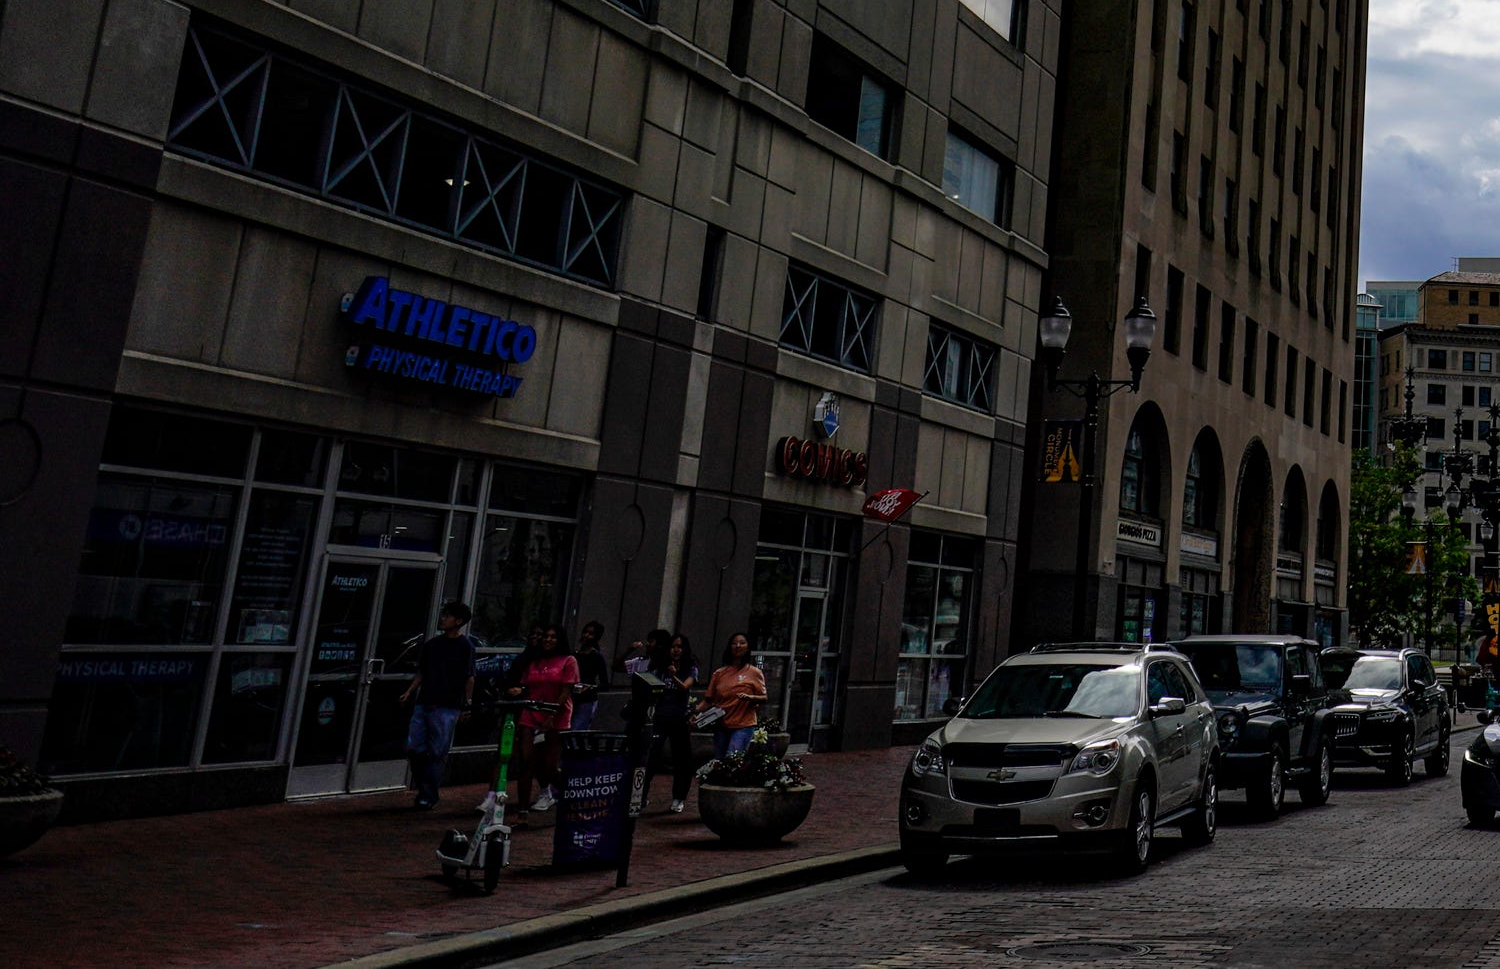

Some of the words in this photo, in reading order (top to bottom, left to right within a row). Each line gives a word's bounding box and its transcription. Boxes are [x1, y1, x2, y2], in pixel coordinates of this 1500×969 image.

[352, 276, 536, 364] ATHLETICO
[365, 345, 449, 385] PHYSICAL
[452, 363, 523, 399] THERAPY
[780, 435, 868, 487] COMICS
[1044, 433, 1056, 476] CIRCLE
[332, 574, 368, 588] ATHLETICO
[56, 661, 127, 678] PHYSICAL
[130, 660, 195, 676] THERAPY
[568, 777, 592, 787] HELP
[595, 773, 623, 784] KEEP
